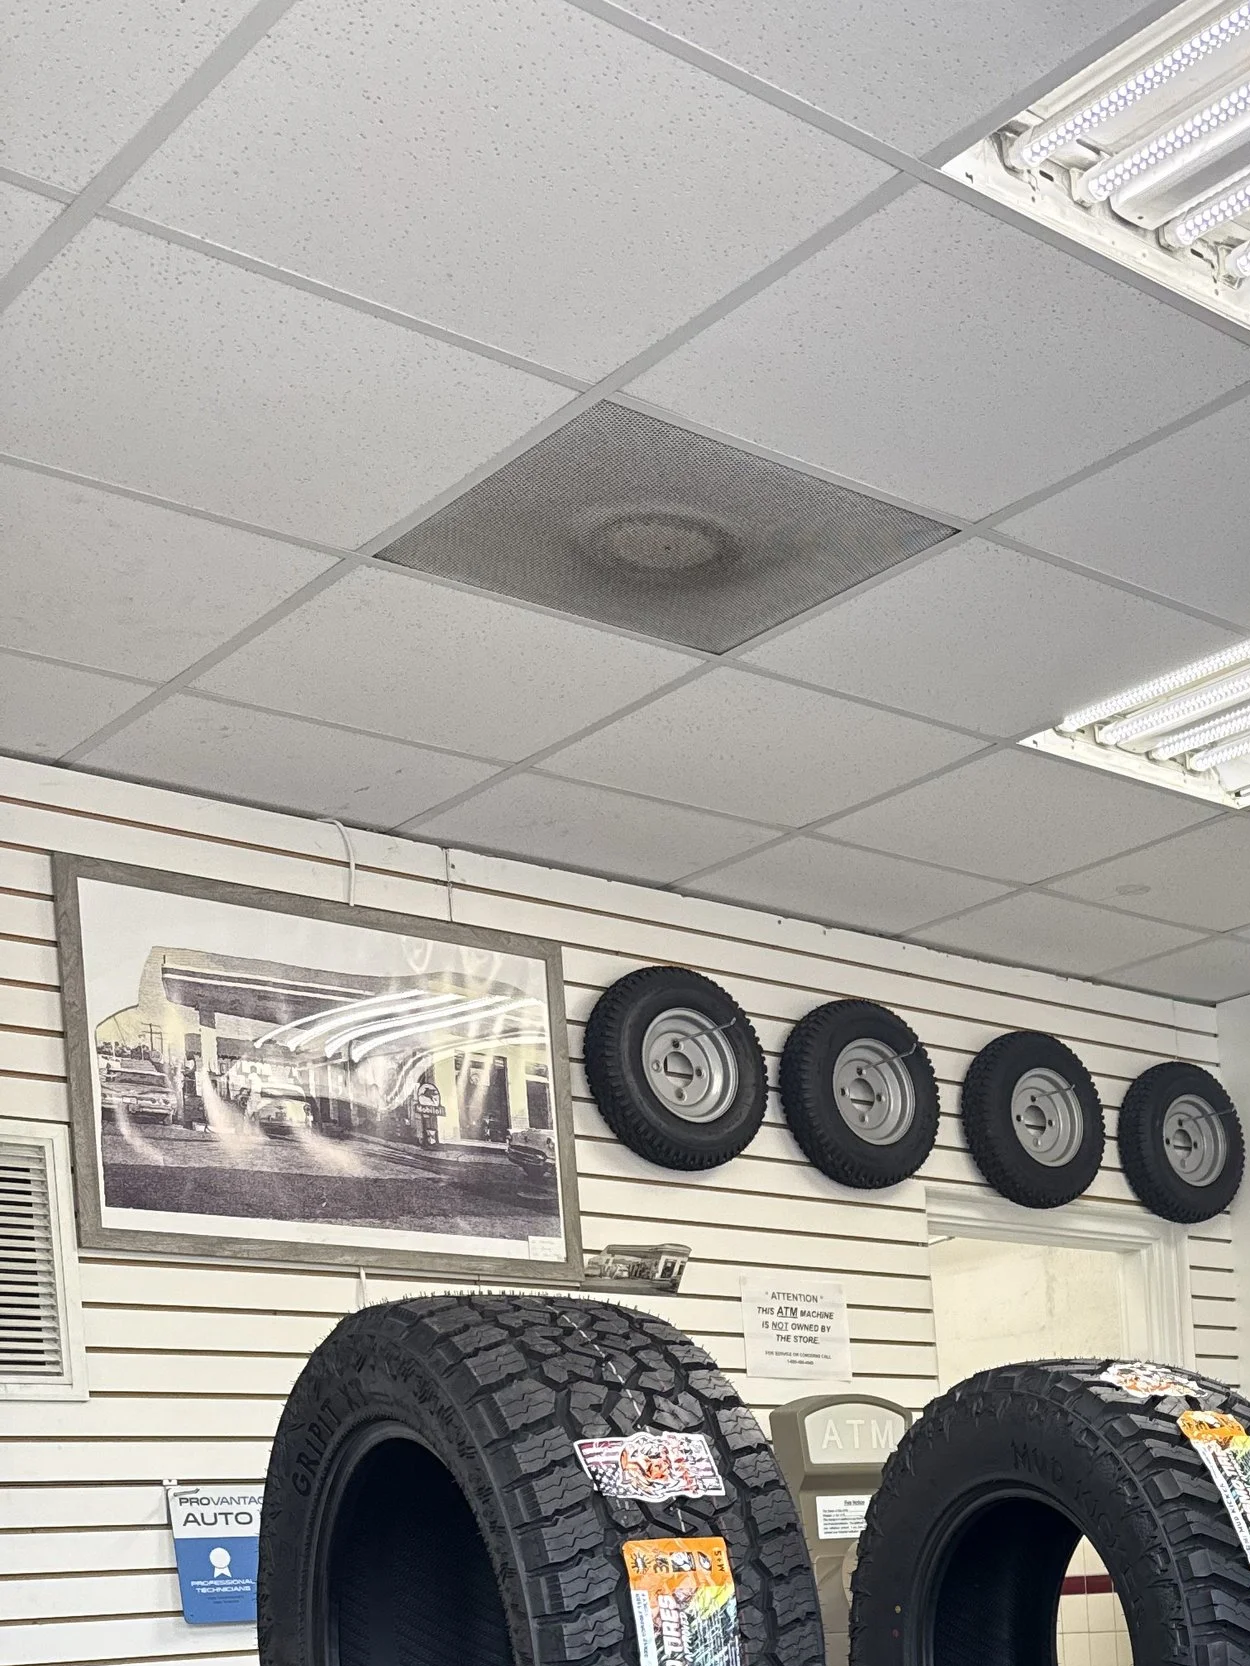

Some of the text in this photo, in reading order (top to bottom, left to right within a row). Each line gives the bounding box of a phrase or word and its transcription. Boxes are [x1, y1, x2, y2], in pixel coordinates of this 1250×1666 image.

[771, 1291, 818, 1303] ATTENTION
[757, 1306, 834, 1320] THIS ATM MACHINE
[762, 1321, 831, 1333] IS NOT OWNED BY
[776, 1334, 820, 1345] THE STORE.
[821, 1419, 895, 1450] ATM
[183, 1511, 254, 1527] AUTO
[190, 1578, 257, 1587] PROFESSIONAL
[196, 1586, 251, 1594] TECHNICIANS
[657, 1593, 683, 1654] TIRES
